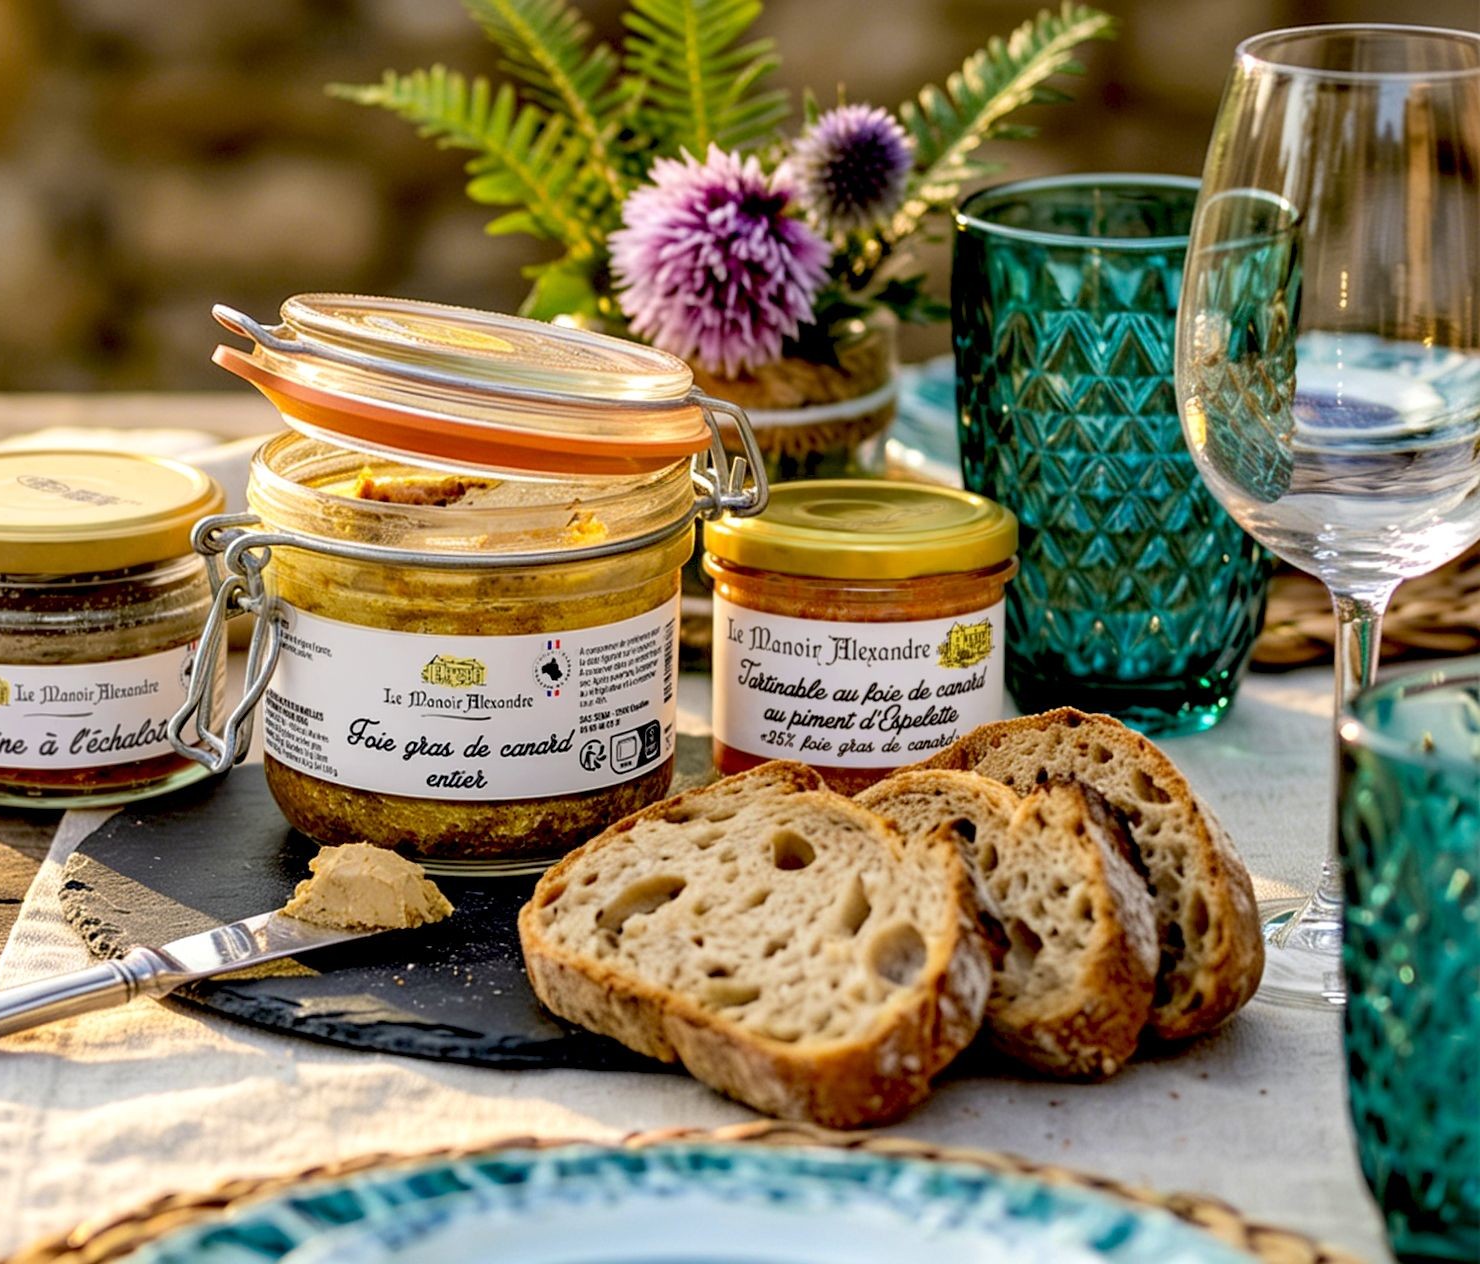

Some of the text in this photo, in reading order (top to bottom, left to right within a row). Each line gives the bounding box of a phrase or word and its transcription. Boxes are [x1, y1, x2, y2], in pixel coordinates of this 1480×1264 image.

[727, 616, 931, 666] Le Manoir Alexandre
[15, 679, 160, 705] Le Manoir Alexandre
[737, 658, 987, 705] Tartinable au foie de canard
[383, 688, 534, 710] Le Manoir Alexandre
[764, 706, 787, 723] au
[788, 708, 855, 731] piment
[39, 732, 59, 756] à
[347, 718, 576, 761] Foie gras de canard
[799, 735, 832, 752] foie
[837, 739, 873, 758] gras
[881, 735, 902, 752] de
[426, 769, 489, 789] entier
